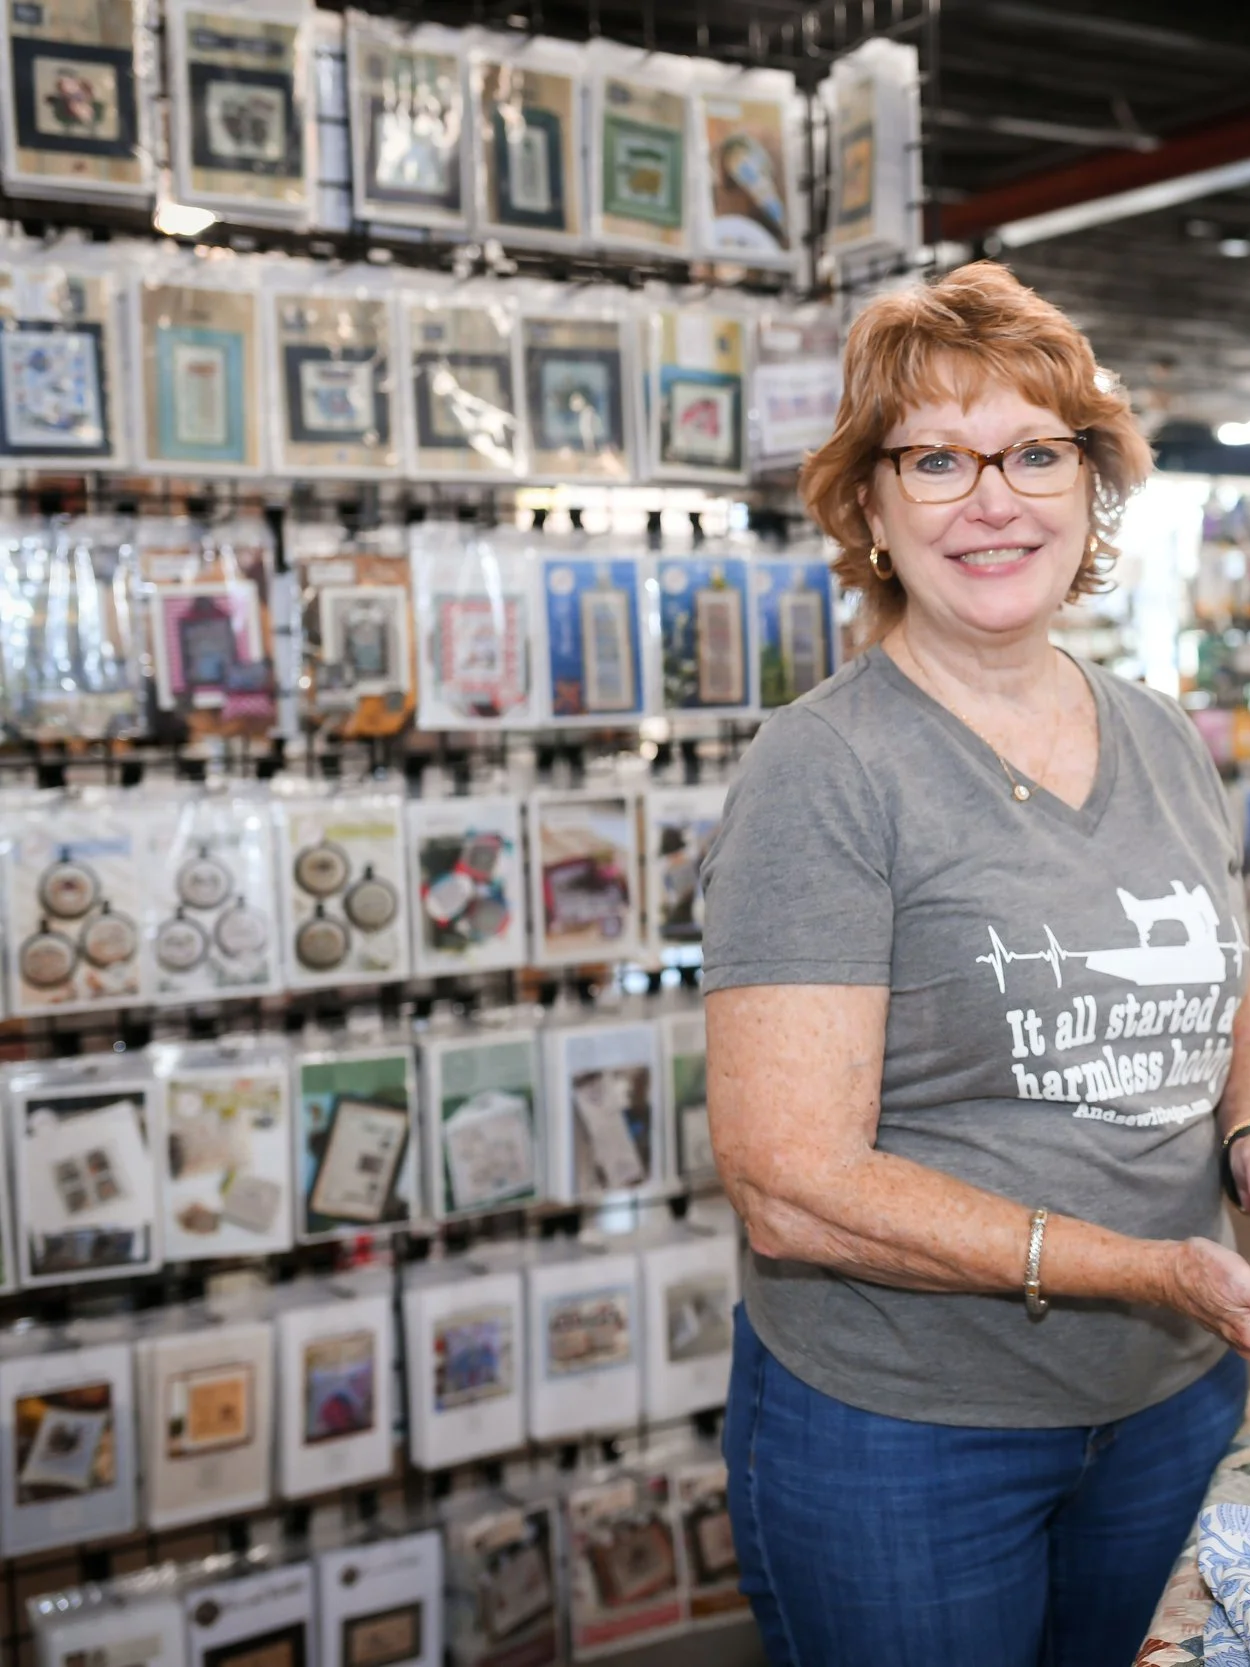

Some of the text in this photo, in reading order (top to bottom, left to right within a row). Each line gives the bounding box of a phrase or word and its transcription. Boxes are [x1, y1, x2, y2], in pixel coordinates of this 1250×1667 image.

[1006, 1009, 1045, 1058] It
[1055, 994, 1097, 1051] all
[1104, 984, 1221, 1041] started
[1011, 1044, 1164, 1103] harmless
